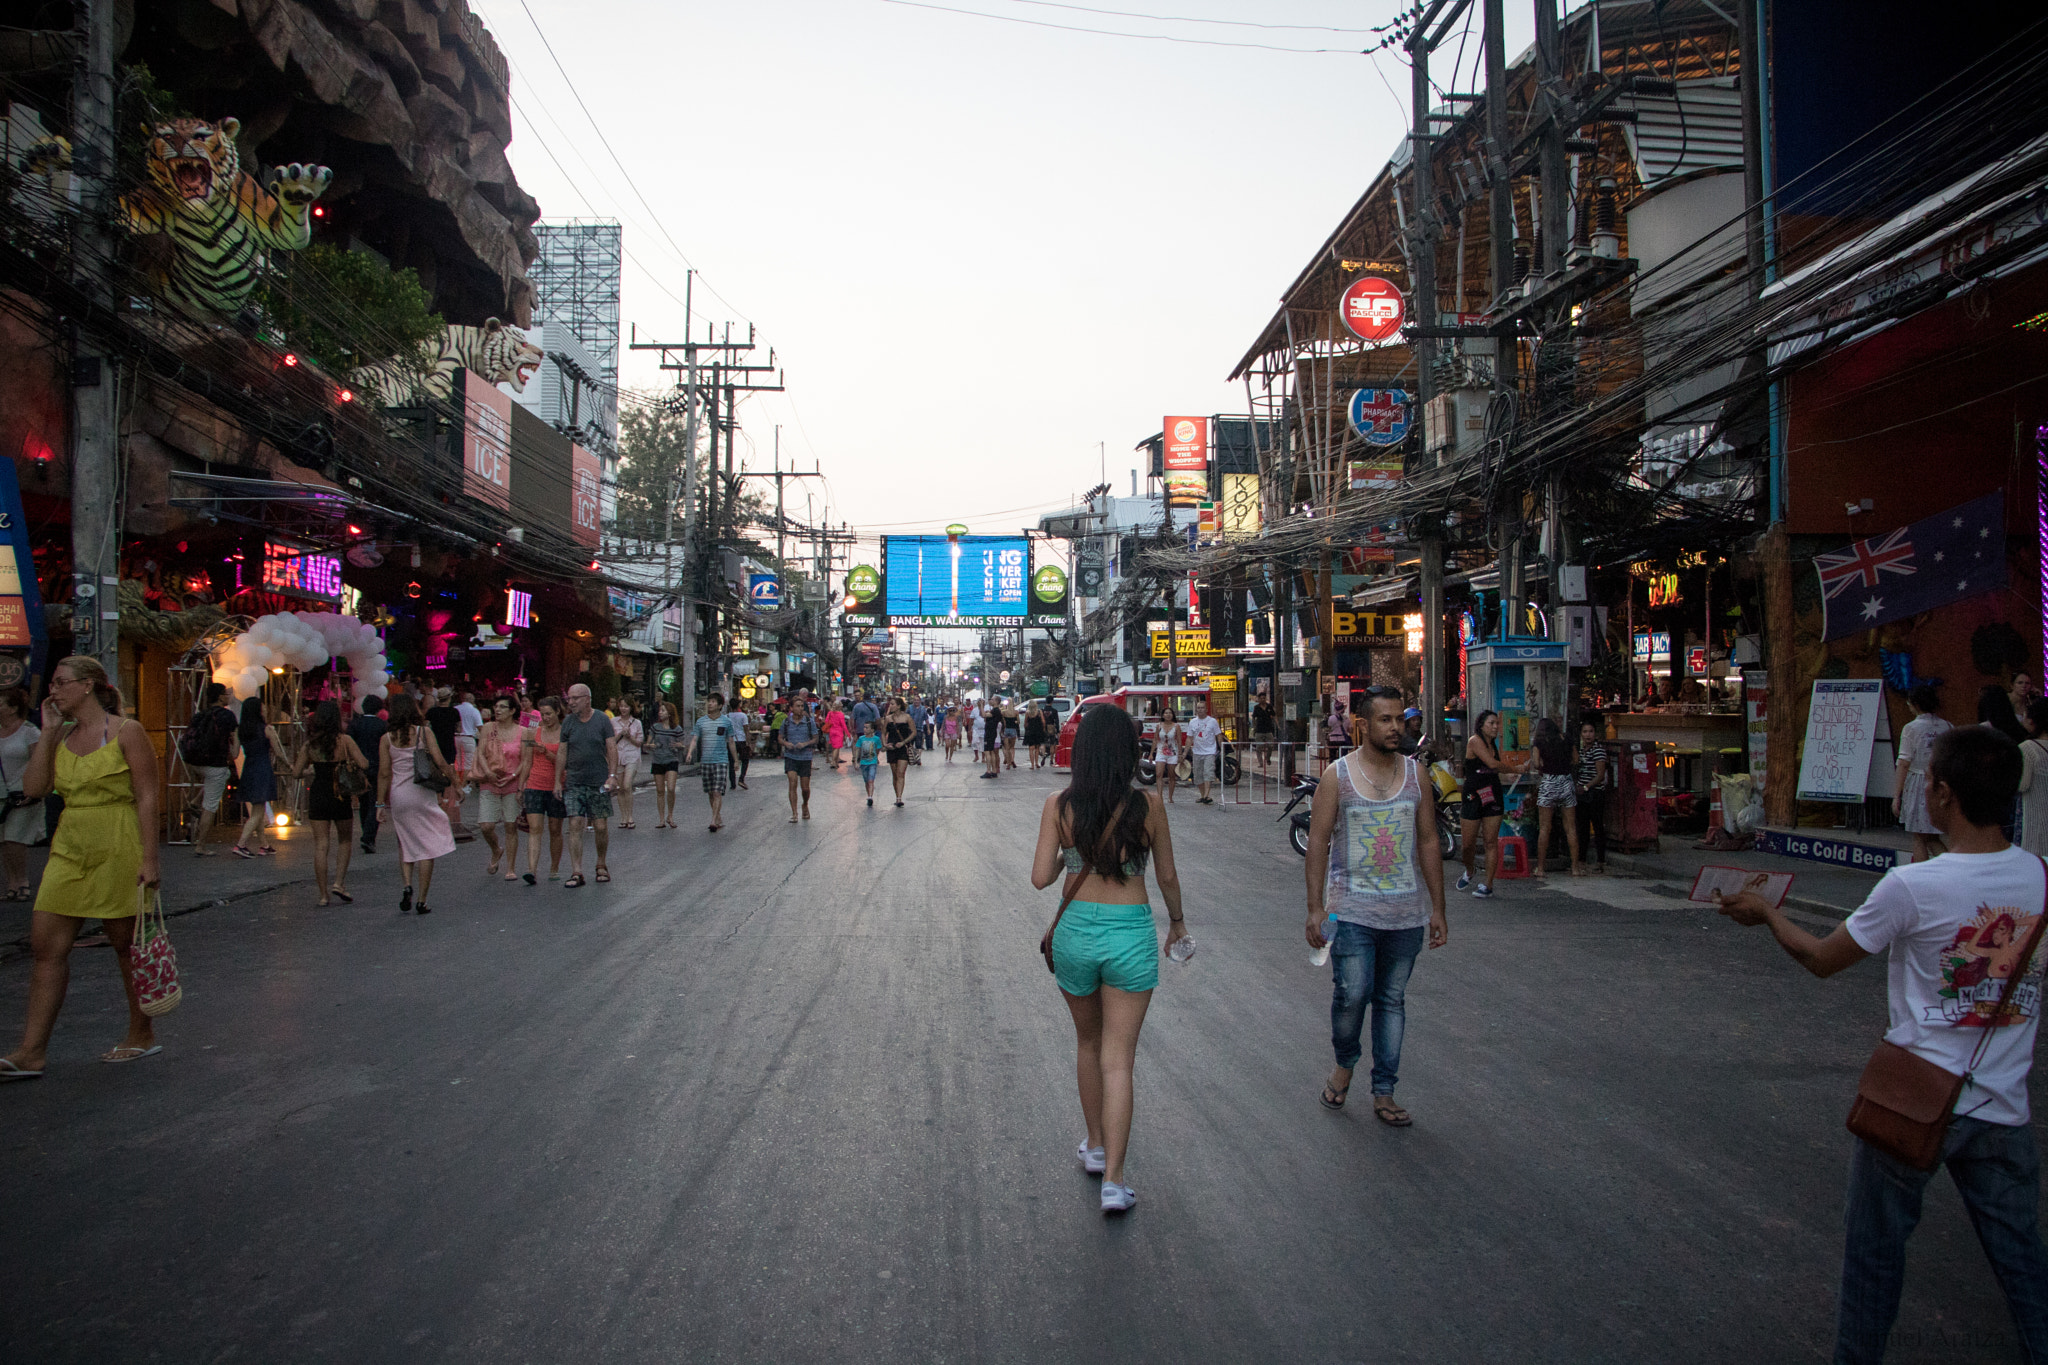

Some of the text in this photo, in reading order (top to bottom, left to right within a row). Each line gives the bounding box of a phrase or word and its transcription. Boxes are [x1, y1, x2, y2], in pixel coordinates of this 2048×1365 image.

[474, 438, 503, 487] ICE
[577, 496, 597, 531] ICE
[849, 582, 877, 593] Chang
[1035, 582, 1064, 593] Chang
[845, 614, 876, 625] Chang
[890, 616, 1025, 626] BANGLA WALKING STREET
[1511, 647, 1545, 657] TOT
[1824, 692, 1850, 706] LIVE
[1814, 706, 1861, 723] SUNDAY
[1814, 724, 1865, 741] UFC 195
[1817, 741, 1856, 755] LAWLER
[1826, 755, 1838, 766] VS
[1811, 766, 1854, 780] CONDIT
[1786, 836, 1892, 868] Ice Cold Beer
